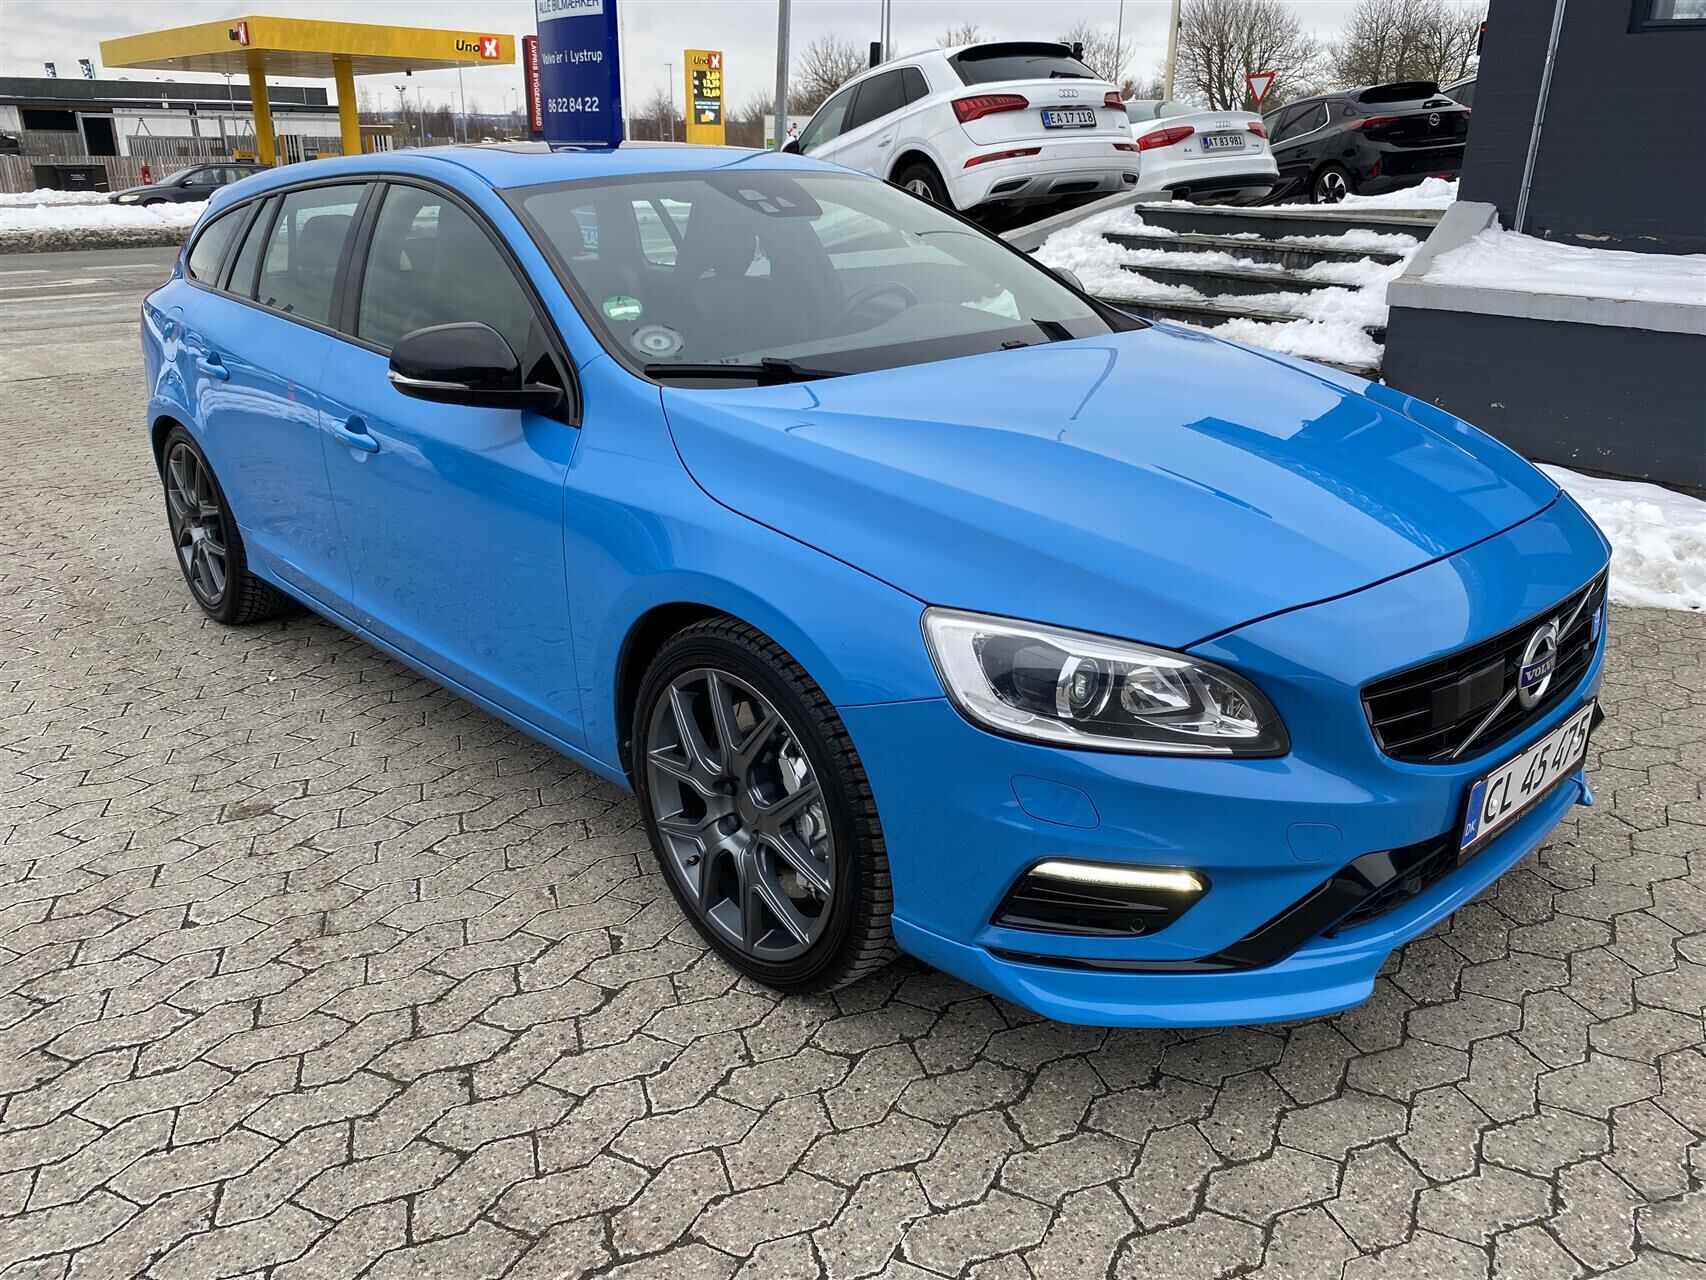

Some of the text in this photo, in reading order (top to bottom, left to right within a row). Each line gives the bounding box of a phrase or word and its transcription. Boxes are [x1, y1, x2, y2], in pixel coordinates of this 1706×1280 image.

[455, 38, 497, 57] Uno X
[570, 49, 603, 65] Lystrup
[693, 54, 720, 68] Uno X
[530, 40, 542, 127] LAVPRIS BYGGEMARKED
[547, 96, 599, 112] 86 22 84 22
[1050, 112, 1093, 123] EA 17 118
[1209, 136, 1242, 147] AT 83 981
[1484, 771, 1513, 824] CL
[1521, 743, 1552, 795] 45
[1551, 712, 1590, 771] 475
[1464, 819, 1477, 837] DK
